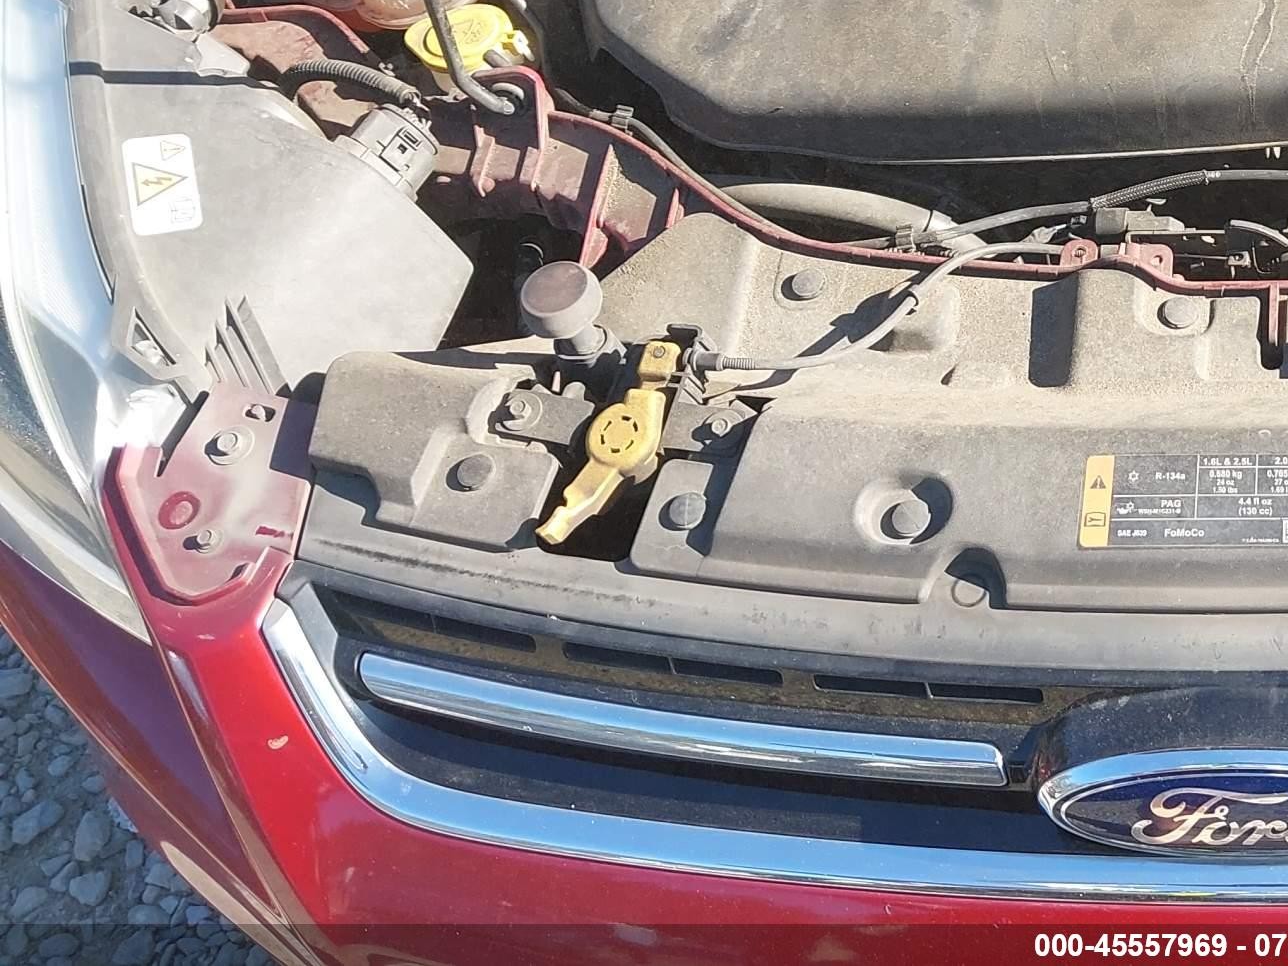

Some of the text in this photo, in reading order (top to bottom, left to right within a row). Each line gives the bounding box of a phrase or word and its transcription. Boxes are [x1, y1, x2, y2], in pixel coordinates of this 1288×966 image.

[1203, 457, 1253, 466] 1.6L & 2.5L
[1155, 472, 1186, 480] R-134a
[1232, 469, 1243, 479] kg
[1267, 469, 1288, 478] 0.765
[1216, 478, 1225, 486] 24
[1228, 486, 1238, 494] lbs
[1161, 499, 1182, 508] PAG
[1238, 497, 1252, 506] 4.4
[1238, 507, 1273, 516] (130 cc)
[1117, 529, 1131, 537] SAE
[1164, 528, 1205, 538] FoMoCo
